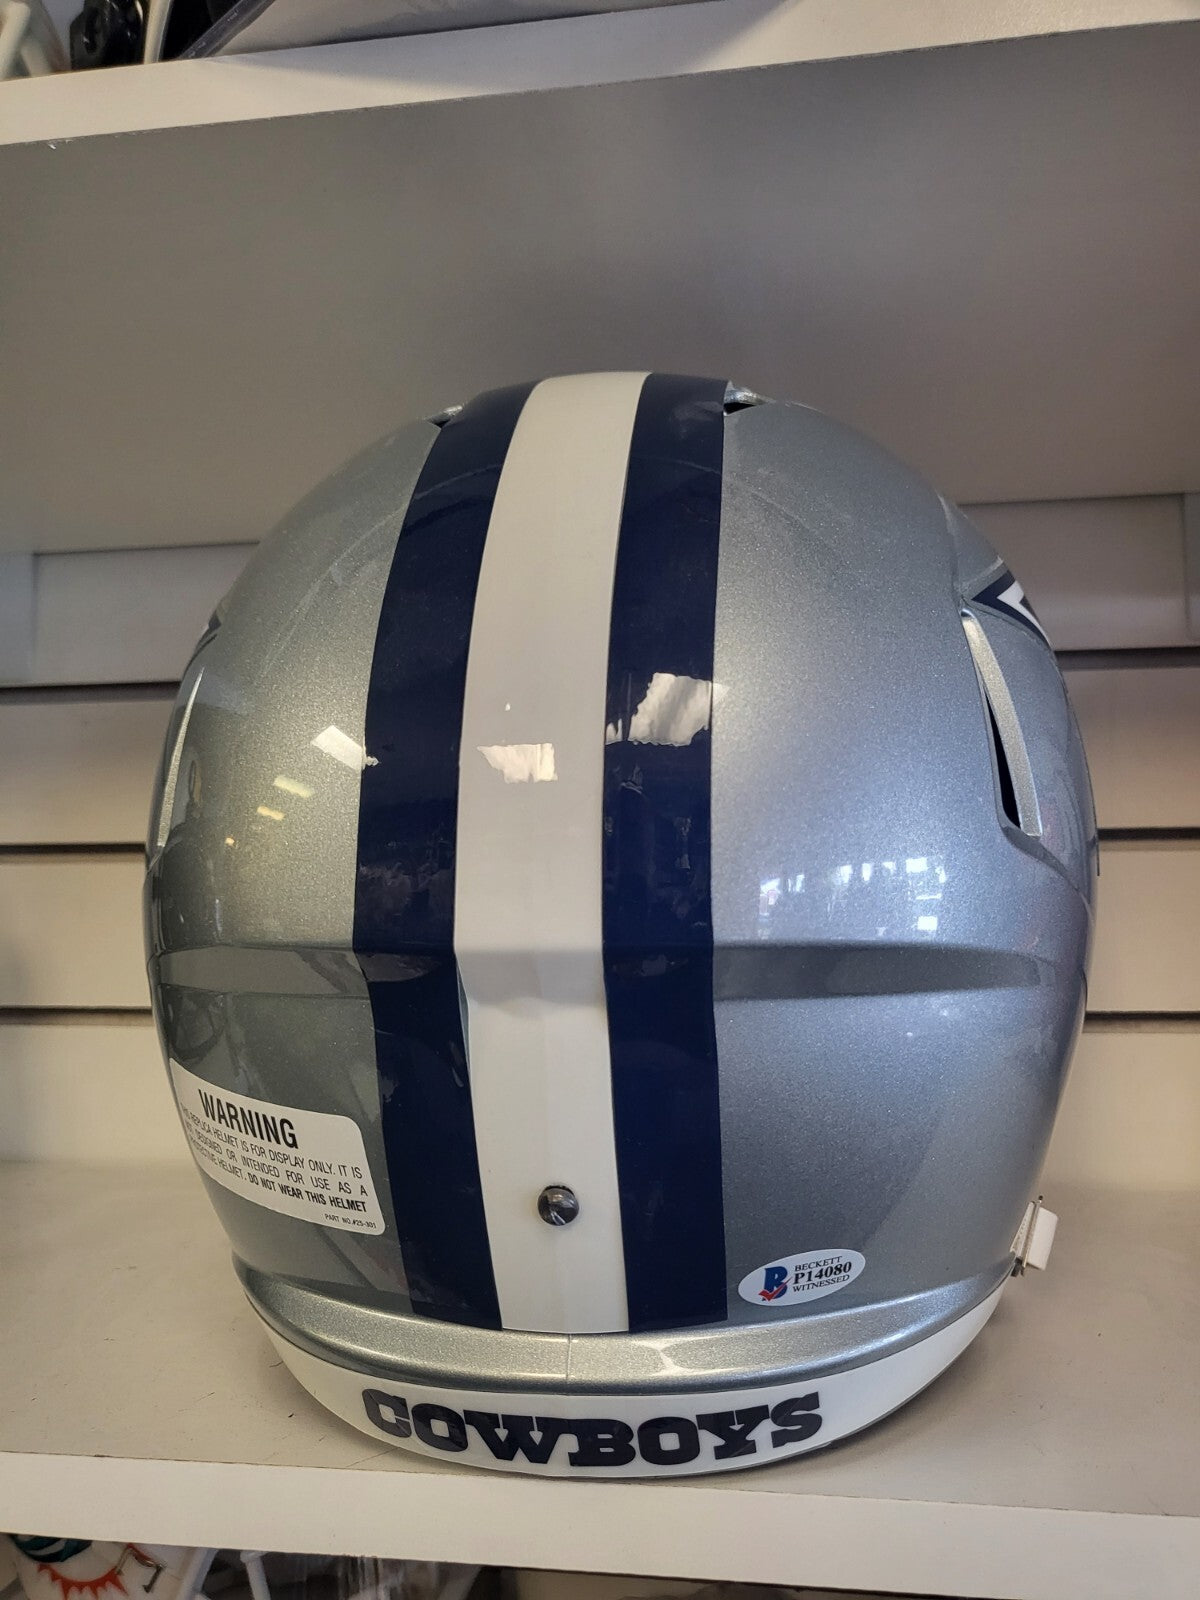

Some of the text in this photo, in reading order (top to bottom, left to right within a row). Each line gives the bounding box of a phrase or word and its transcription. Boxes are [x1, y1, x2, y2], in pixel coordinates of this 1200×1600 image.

[198, 1089, 299, 1149] WARNING
[212, 1126, 239, 1149] HELMET
[240, 1139, 249, 1152] IS
[250, 1143, 267, 1159] FOR
[269, 1149, 305, 1169] DISPLAY
[308, 1159, 336, 1175] ONLY.
[338, 1164, 348, 1177] IT
[351, 1166, 363, 1179] IS
[226, 1147, 238, 1163] OR
[241, 1154, 280, 1178] INTENDED
[286, 1169, 305, 1185] FOR
[310, 1175, 331, 1191] USE
[338, 1181, 352, 1194] AS
[360, 1184, 369, 1197] A
[247, 1171, 260, 1186] DO
[260, 1176, 277, 1192] NOT
[278, 1182, 304, 1200] WEAR
[305, 1190, 327, 1206] THIS
[329, 1195, 367, 1212] HELMET
[324, 1213, 340, 1223] PART
[792, 1274, 850, 1293] WITNESSED
[793, 1261, 852, 1285] P14080
[794, 1255, 843, 1272] BECKETT
[362, 1387, 823, 1467] COWBOYS
